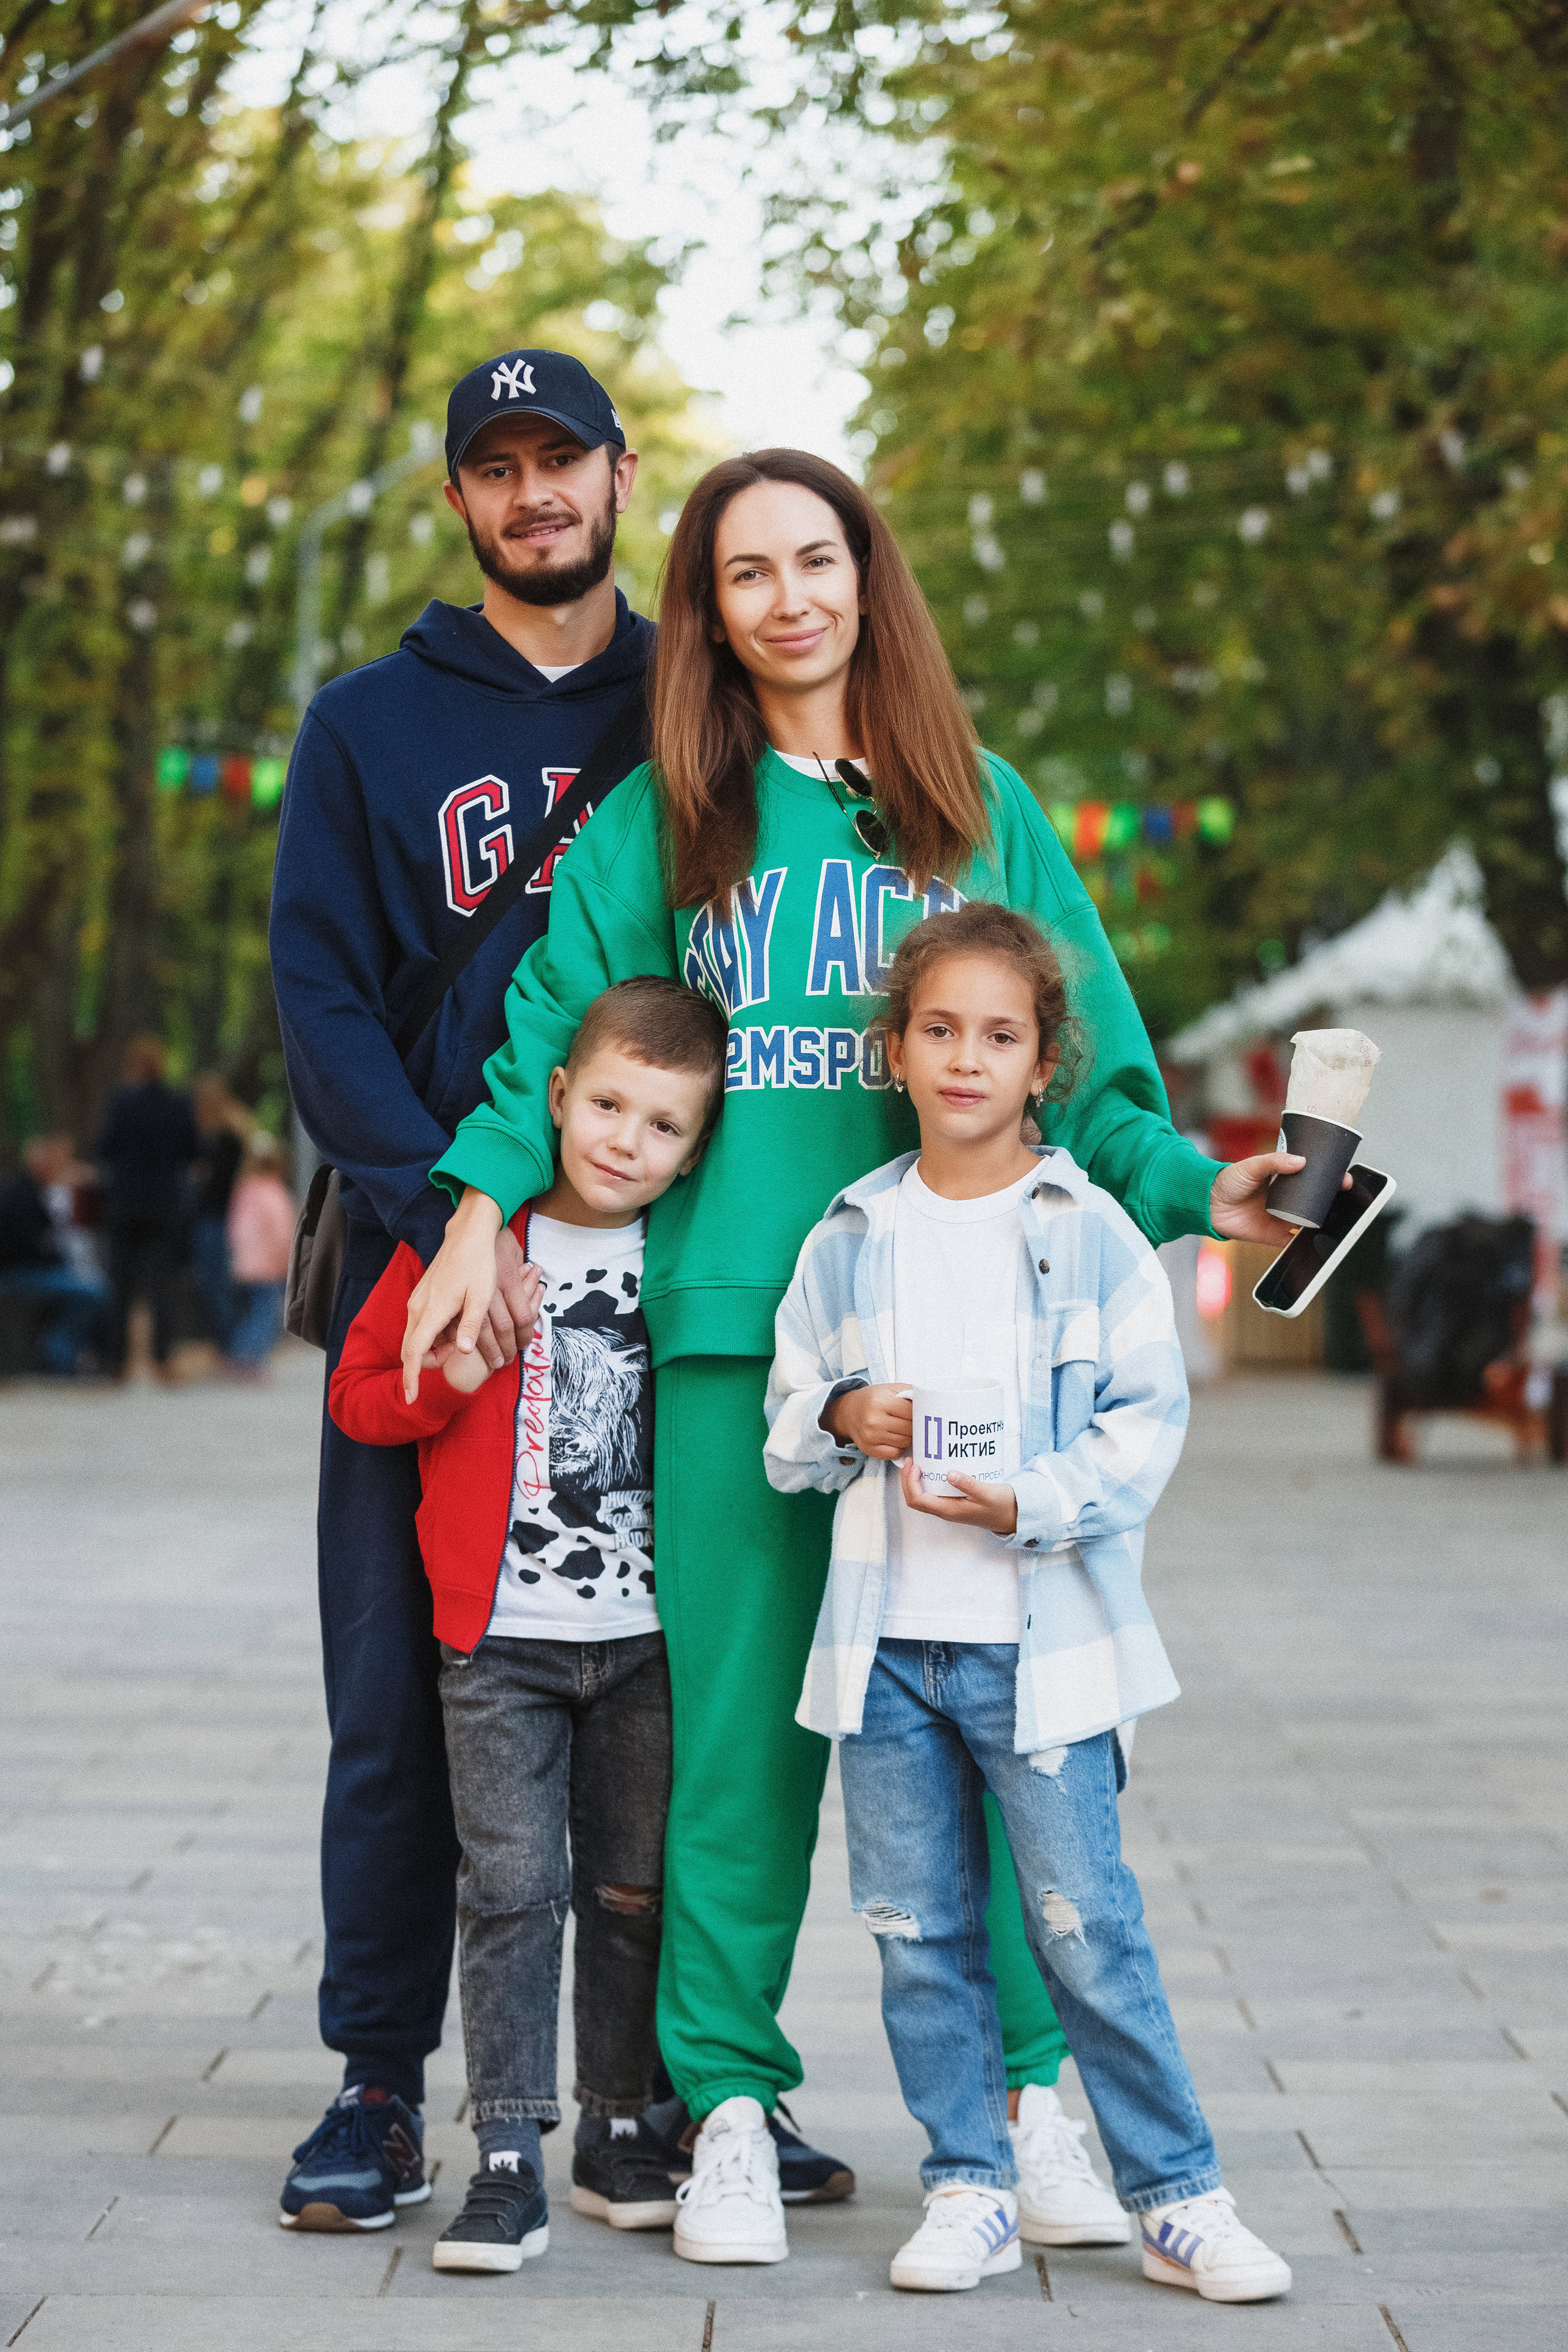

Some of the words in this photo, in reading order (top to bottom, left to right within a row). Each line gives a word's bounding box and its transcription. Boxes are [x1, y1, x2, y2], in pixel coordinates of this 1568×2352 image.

[491, 359, 537, 401] NY
[805, 859, 969, 997] AC
[724, 1025, 897, 1094] 2MSPO
[948, 1441, 995, 1457] ИКТИБ
